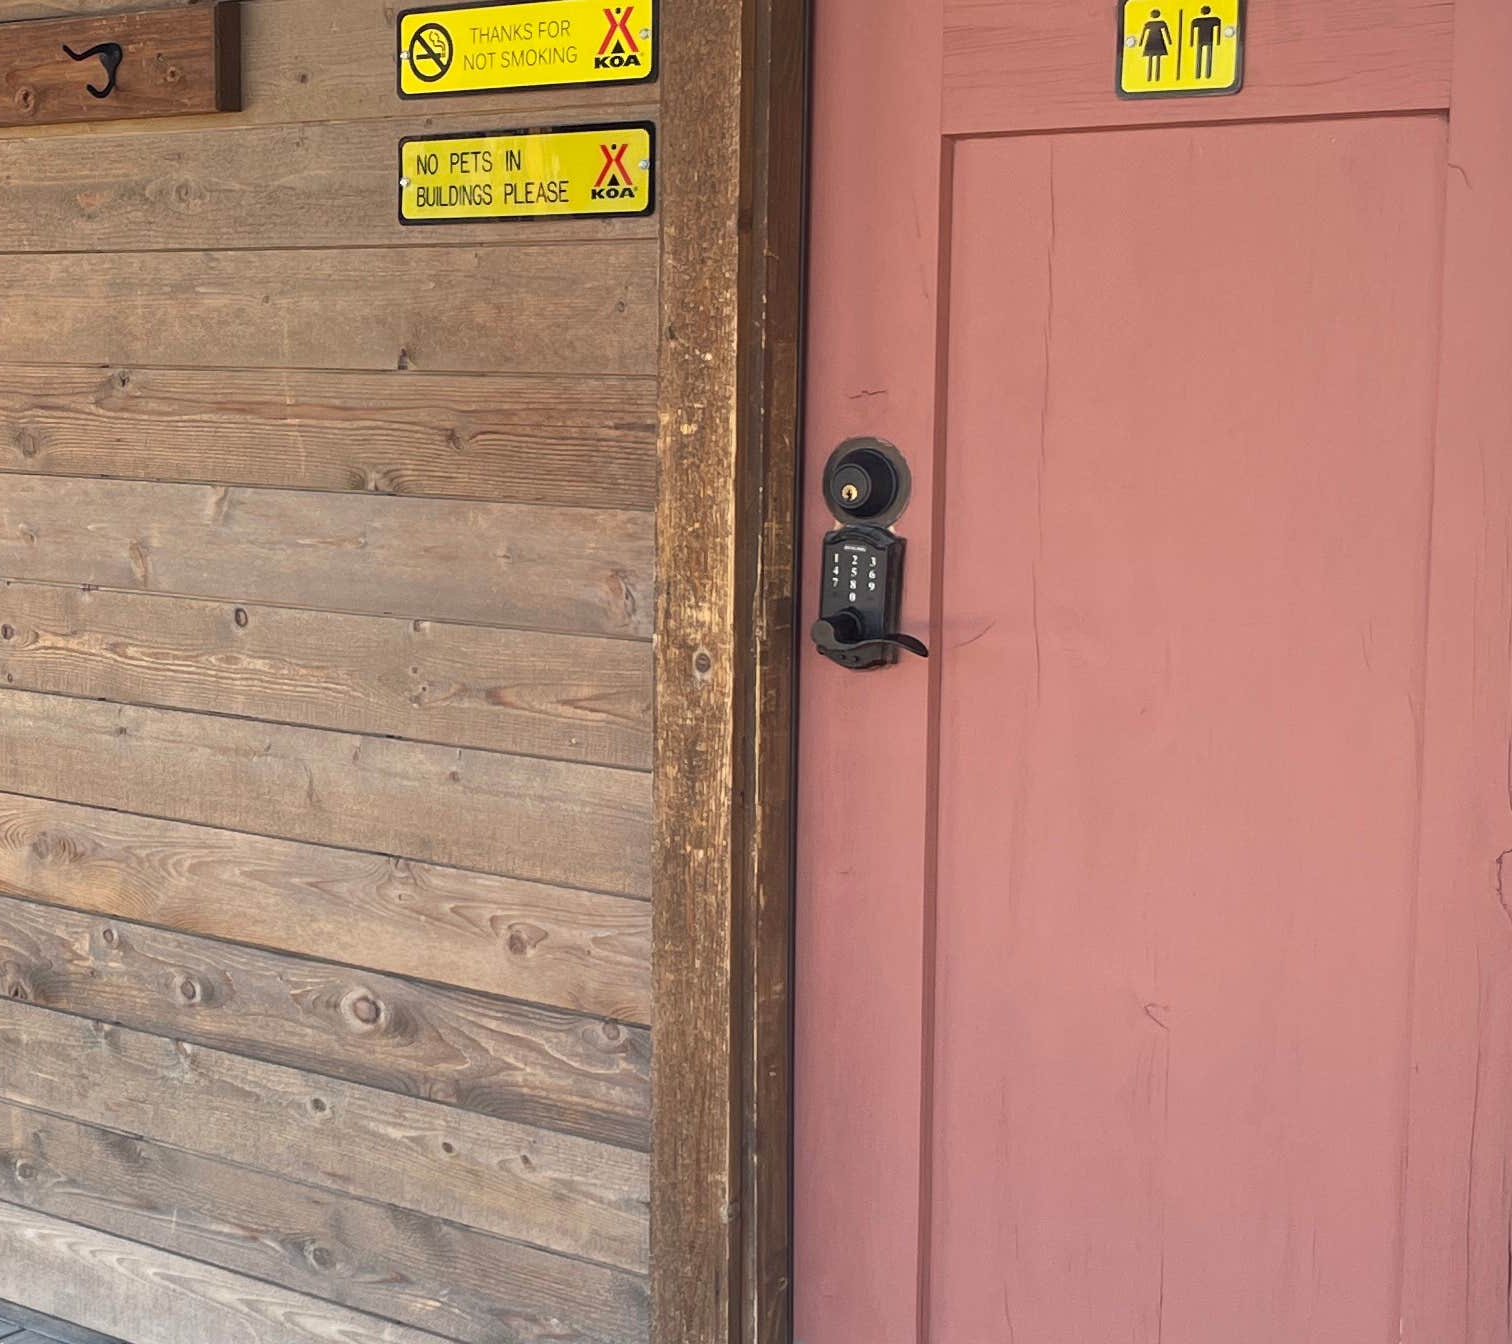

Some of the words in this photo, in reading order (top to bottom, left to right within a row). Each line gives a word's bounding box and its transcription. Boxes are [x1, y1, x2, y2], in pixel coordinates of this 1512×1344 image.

[470, 22, 533, 45] THANKS
[538, 20, 571, 40] FOR
[463, 52, 496, 71] NOT
[501, 46, 578, 69] SMOKING
[594, 54, 641, 69] KOA
[416, 154, 438, 175] NO
[450, 151, 492, 174] PETS
[505, 150, 521, 171] IN
[416, 184, 493, 207] BUILDINGS
[504, 181, 569, 204] PLEASE
[591, 188, 636, 200] KOA
[851, 554, 858, 565] 2
[869, 570, 876, 579] 6
[850, 579, 857, 590] 8
[868, 581, 876, 591] 9
